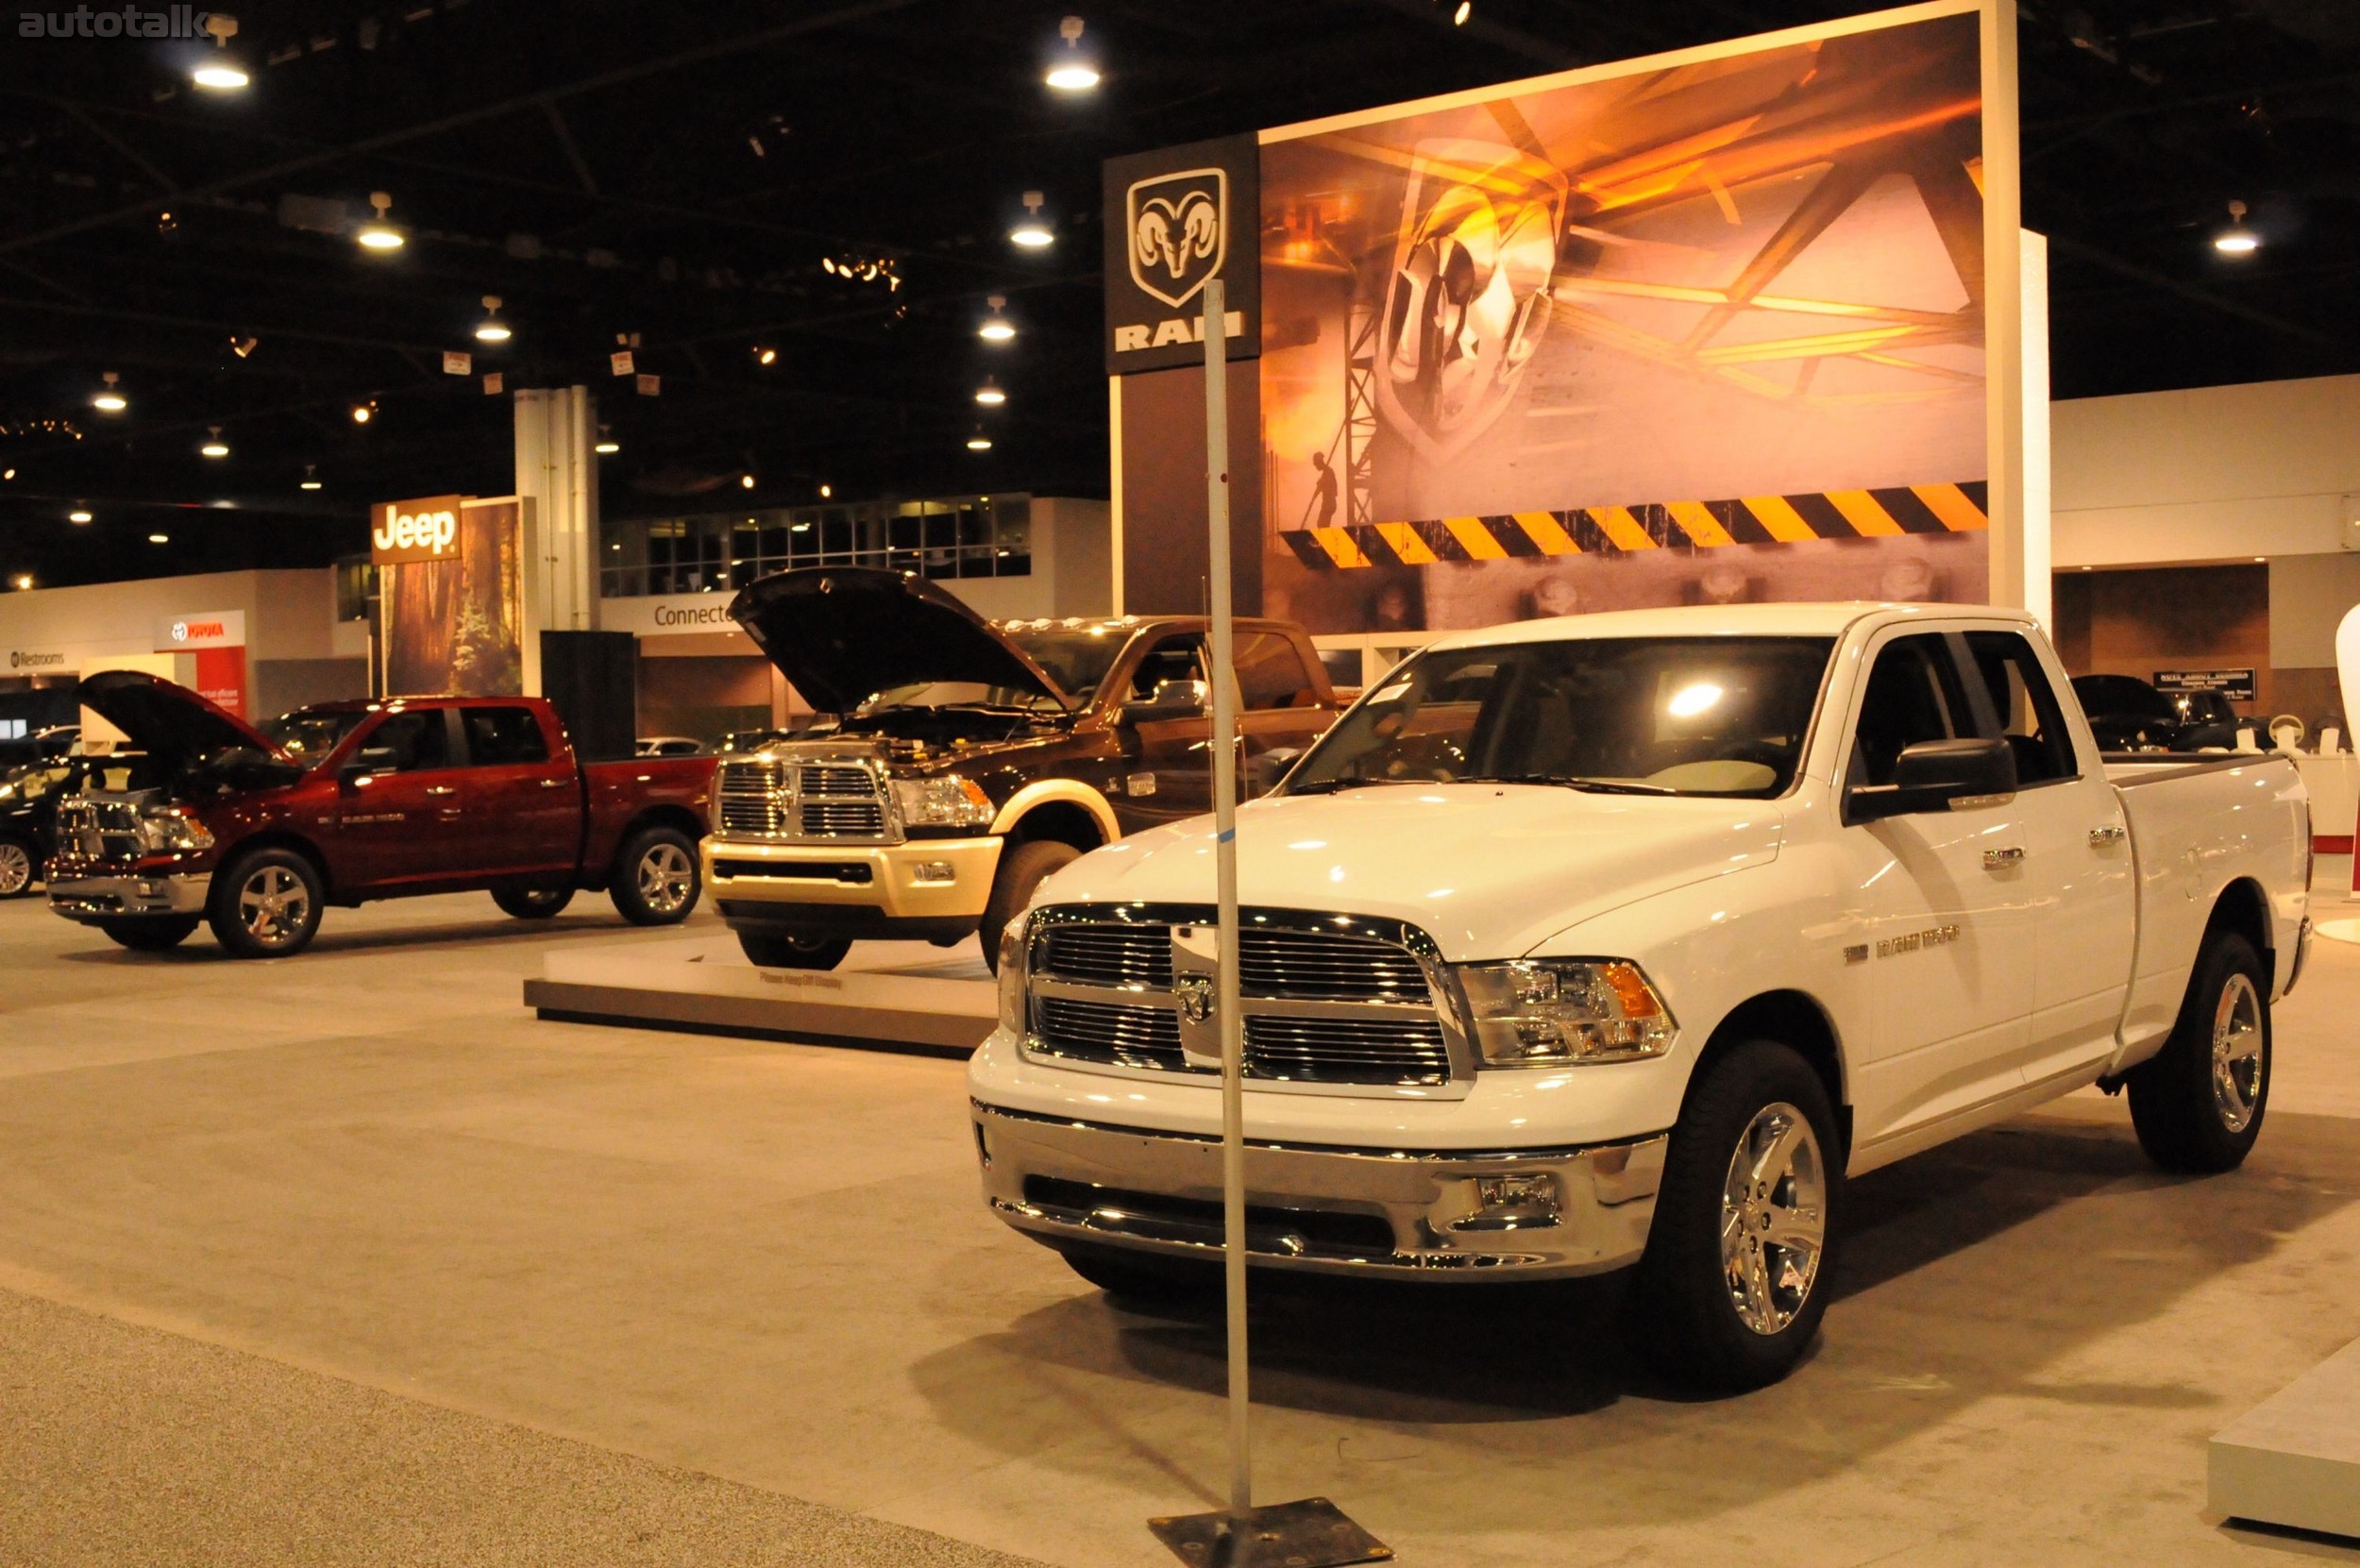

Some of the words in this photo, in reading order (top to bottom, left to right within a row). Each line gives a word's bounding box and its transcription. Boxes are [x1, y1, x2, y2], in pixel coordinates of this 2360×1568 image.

[1115, 312, 1242, 352] RAM
[374, 504, 455, 555] Jeep
[188, 622, 225, 638] TOYOTA
[21, 651, 64, 666] Restrooms
